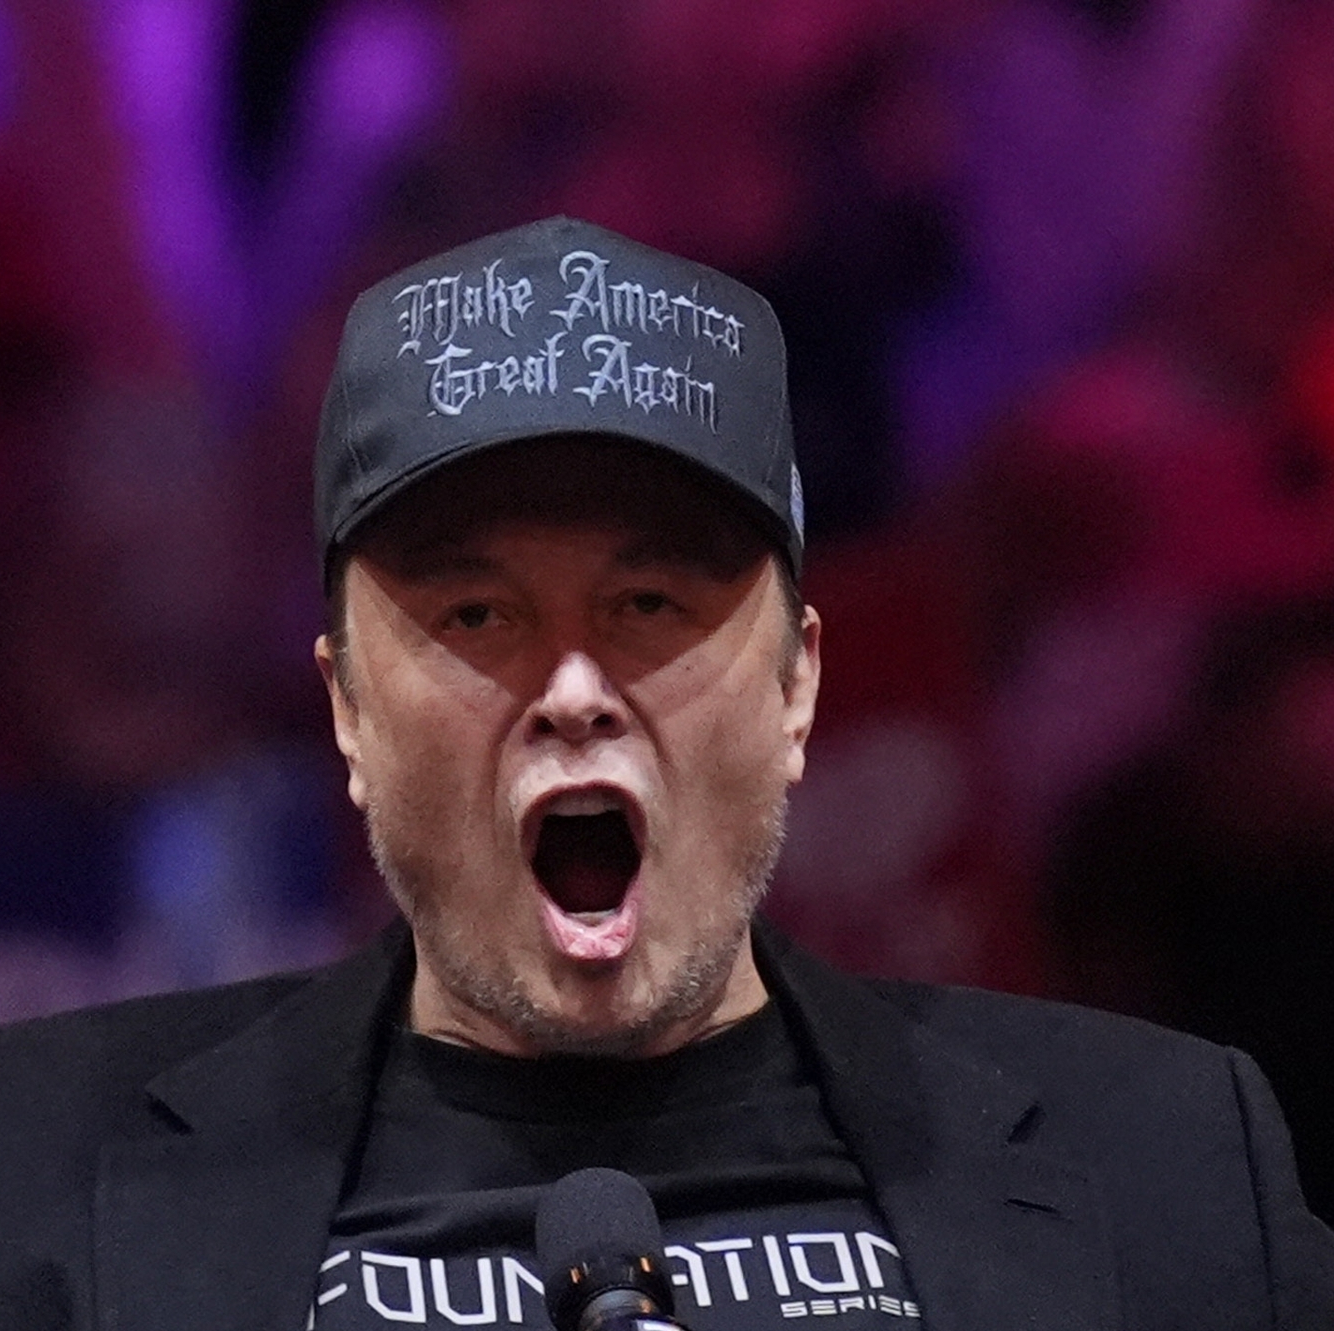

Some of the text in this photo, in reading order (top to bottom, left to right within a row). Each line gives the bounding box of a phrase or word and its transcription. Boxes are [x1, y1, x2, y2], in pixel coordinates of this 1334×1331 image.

[393, 250, 746, 360] Make America
[424, 331, 719, 436] Great Again
[779, 1295, 923, 1319] SERIES
